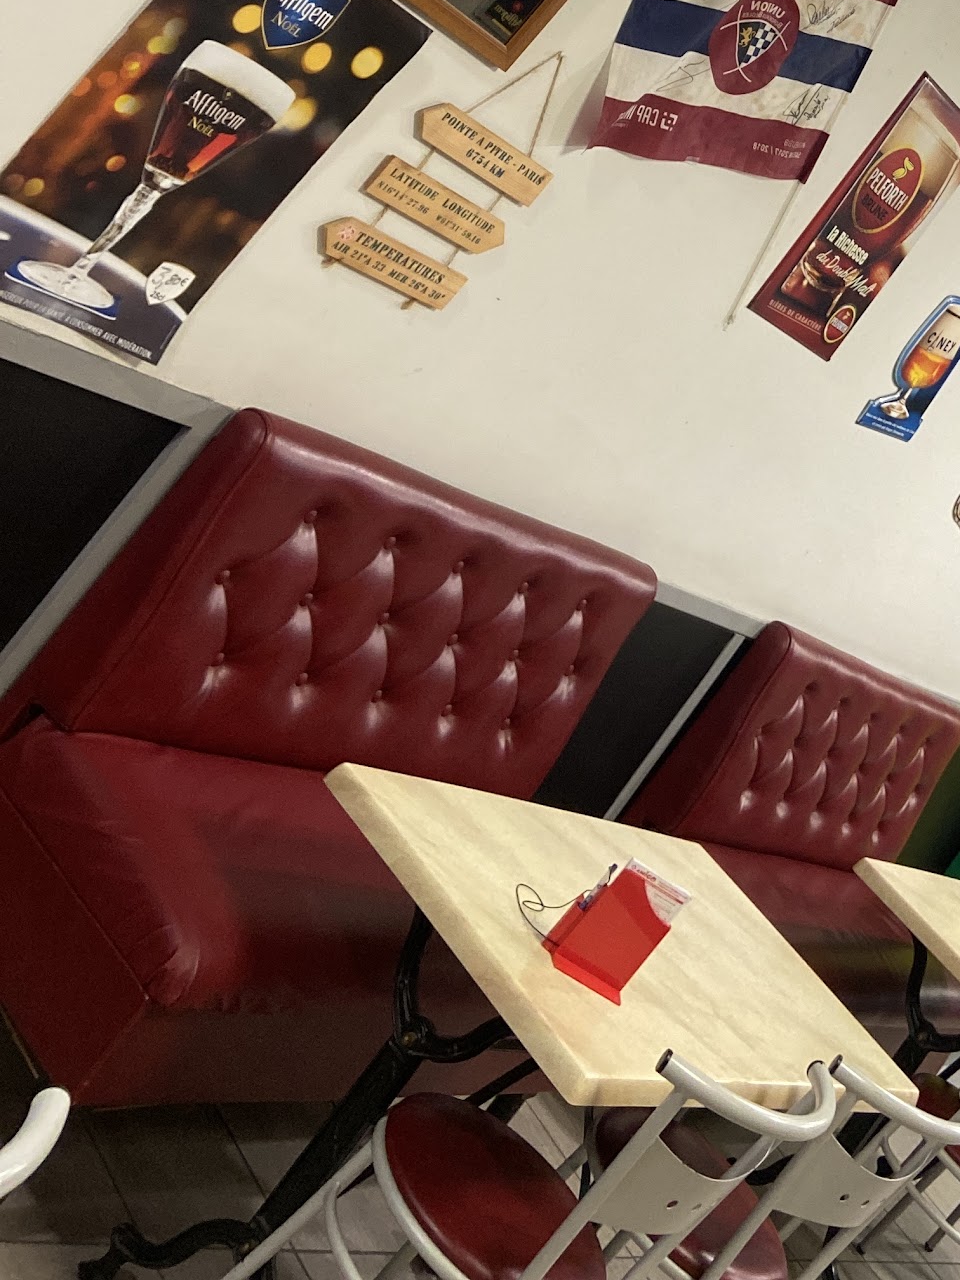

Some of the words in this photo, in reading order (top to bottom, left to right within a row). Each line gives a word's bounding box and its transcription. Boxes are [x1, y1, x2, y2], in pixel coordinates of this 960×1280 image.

[182, 81, 246, 140] Affligem
[441, 111, 478, 141] POINTE
[476, 135, 486, 146] A
[483, 140, 513, 165] PITRE
[516, 162, 545, 186] PARIS
[465, 147, 490, 169] 6754
[488, 163, 505, 178] KM
[389, 166, 439, 202] LATITUDE
[441, 197, 495, 235] LONGITUDE
[859, 192, 889, 221] BRUNE
[865, 168, 909, 211] PELFORTH
[825, 225, 842, 242] la
[832, 231, 870, 267] Richesse
[331, 239, 350, 255] AIR
[371, 259, 386, 273] 33
[387, 267, 408, 285] MER
[354, 231, 445, 286] TEMPERATURES
[815, 245, 835, 265] du
[847, 270, 879, 301] Malt
[785, 308, 796, 317] DE
[925, 329, 956, 355] CINEY
